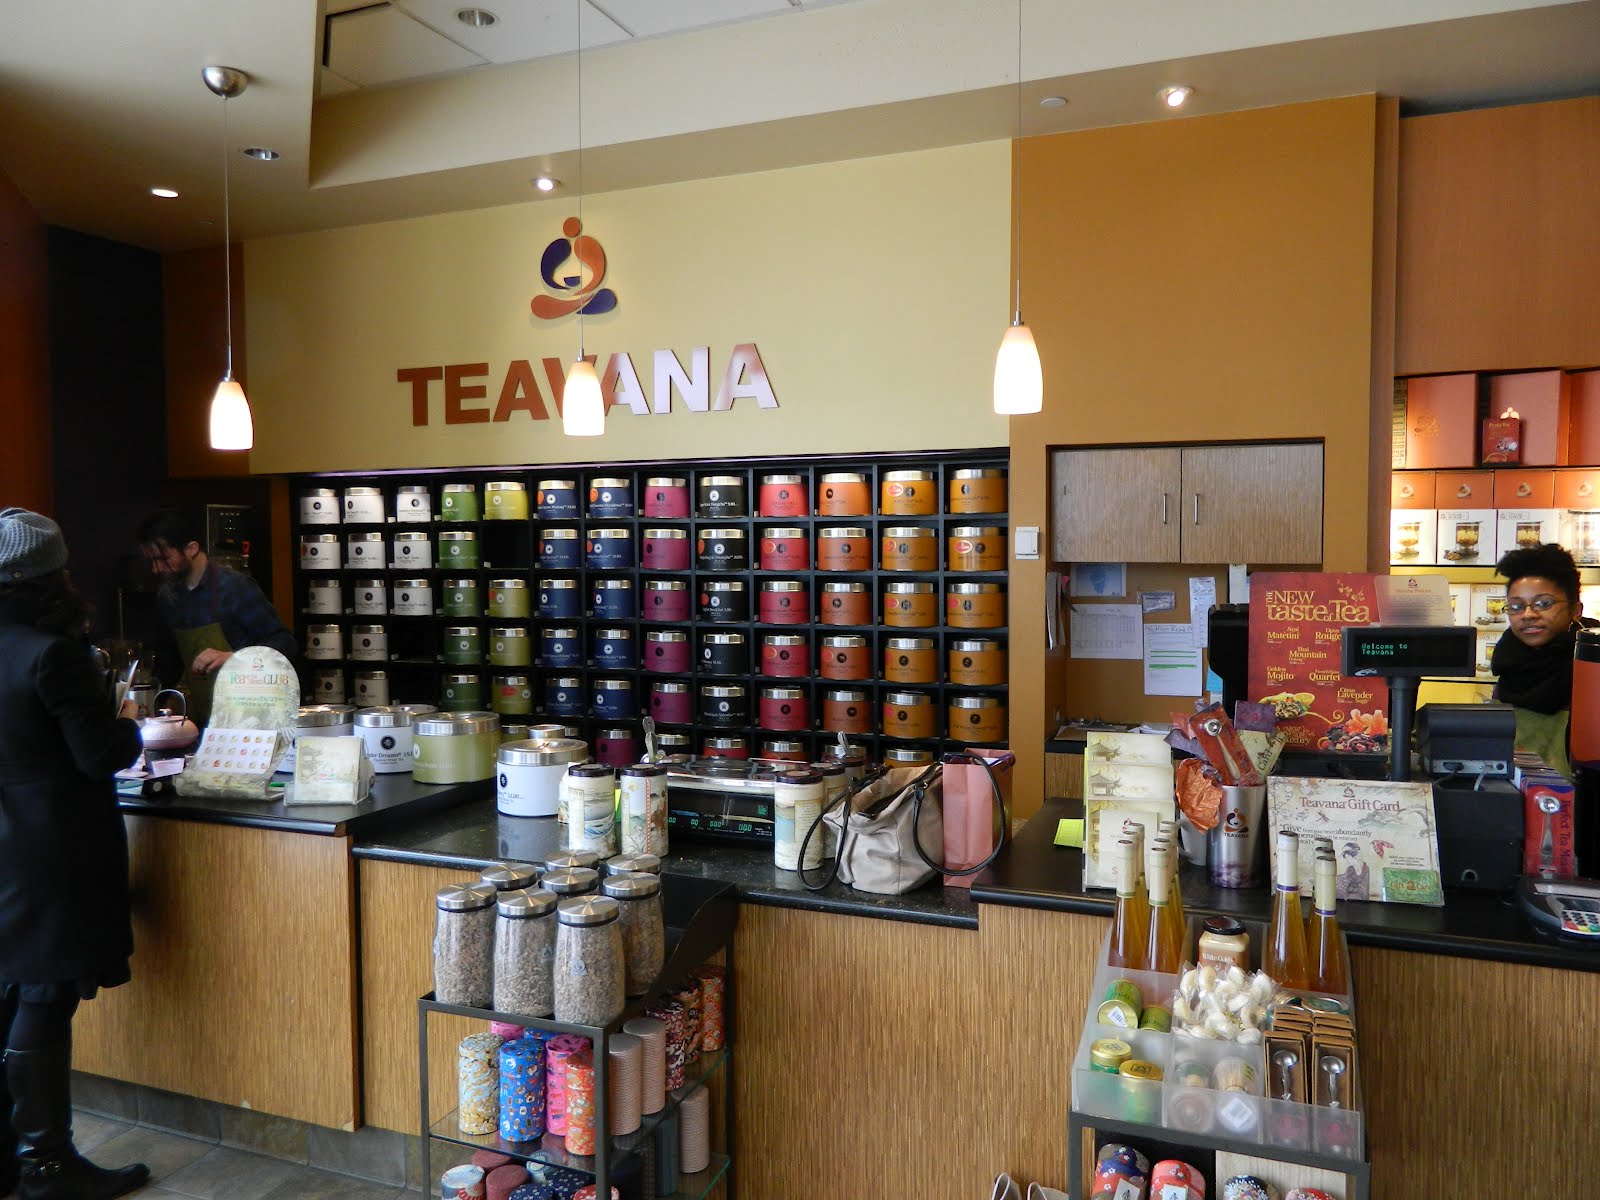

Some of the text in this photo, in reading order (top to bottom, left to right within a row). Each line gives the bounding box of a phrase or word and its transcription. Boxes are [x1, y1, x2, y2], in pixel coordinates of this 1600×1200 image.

[1274, 591, 1316, 604] NEW
[1266, 604, 1328, 621] taste
[1324, 612, 1333, 621] of
[1328, 600, 1371, 622] Tea
[1315, 632, 1342, 641] Rouge
[1289, 651, 1327, 659] Mountain
[264, 674, 289, 685] CLUB
[1267, 672, 1295, 681] Mojito
[1337, 691, 1374, 700] Lavender
[1348, 797, 1372, 810] Gift
[1372, 799, 1400, 812] Card
[1560, 832, 1571, 847] Tea
